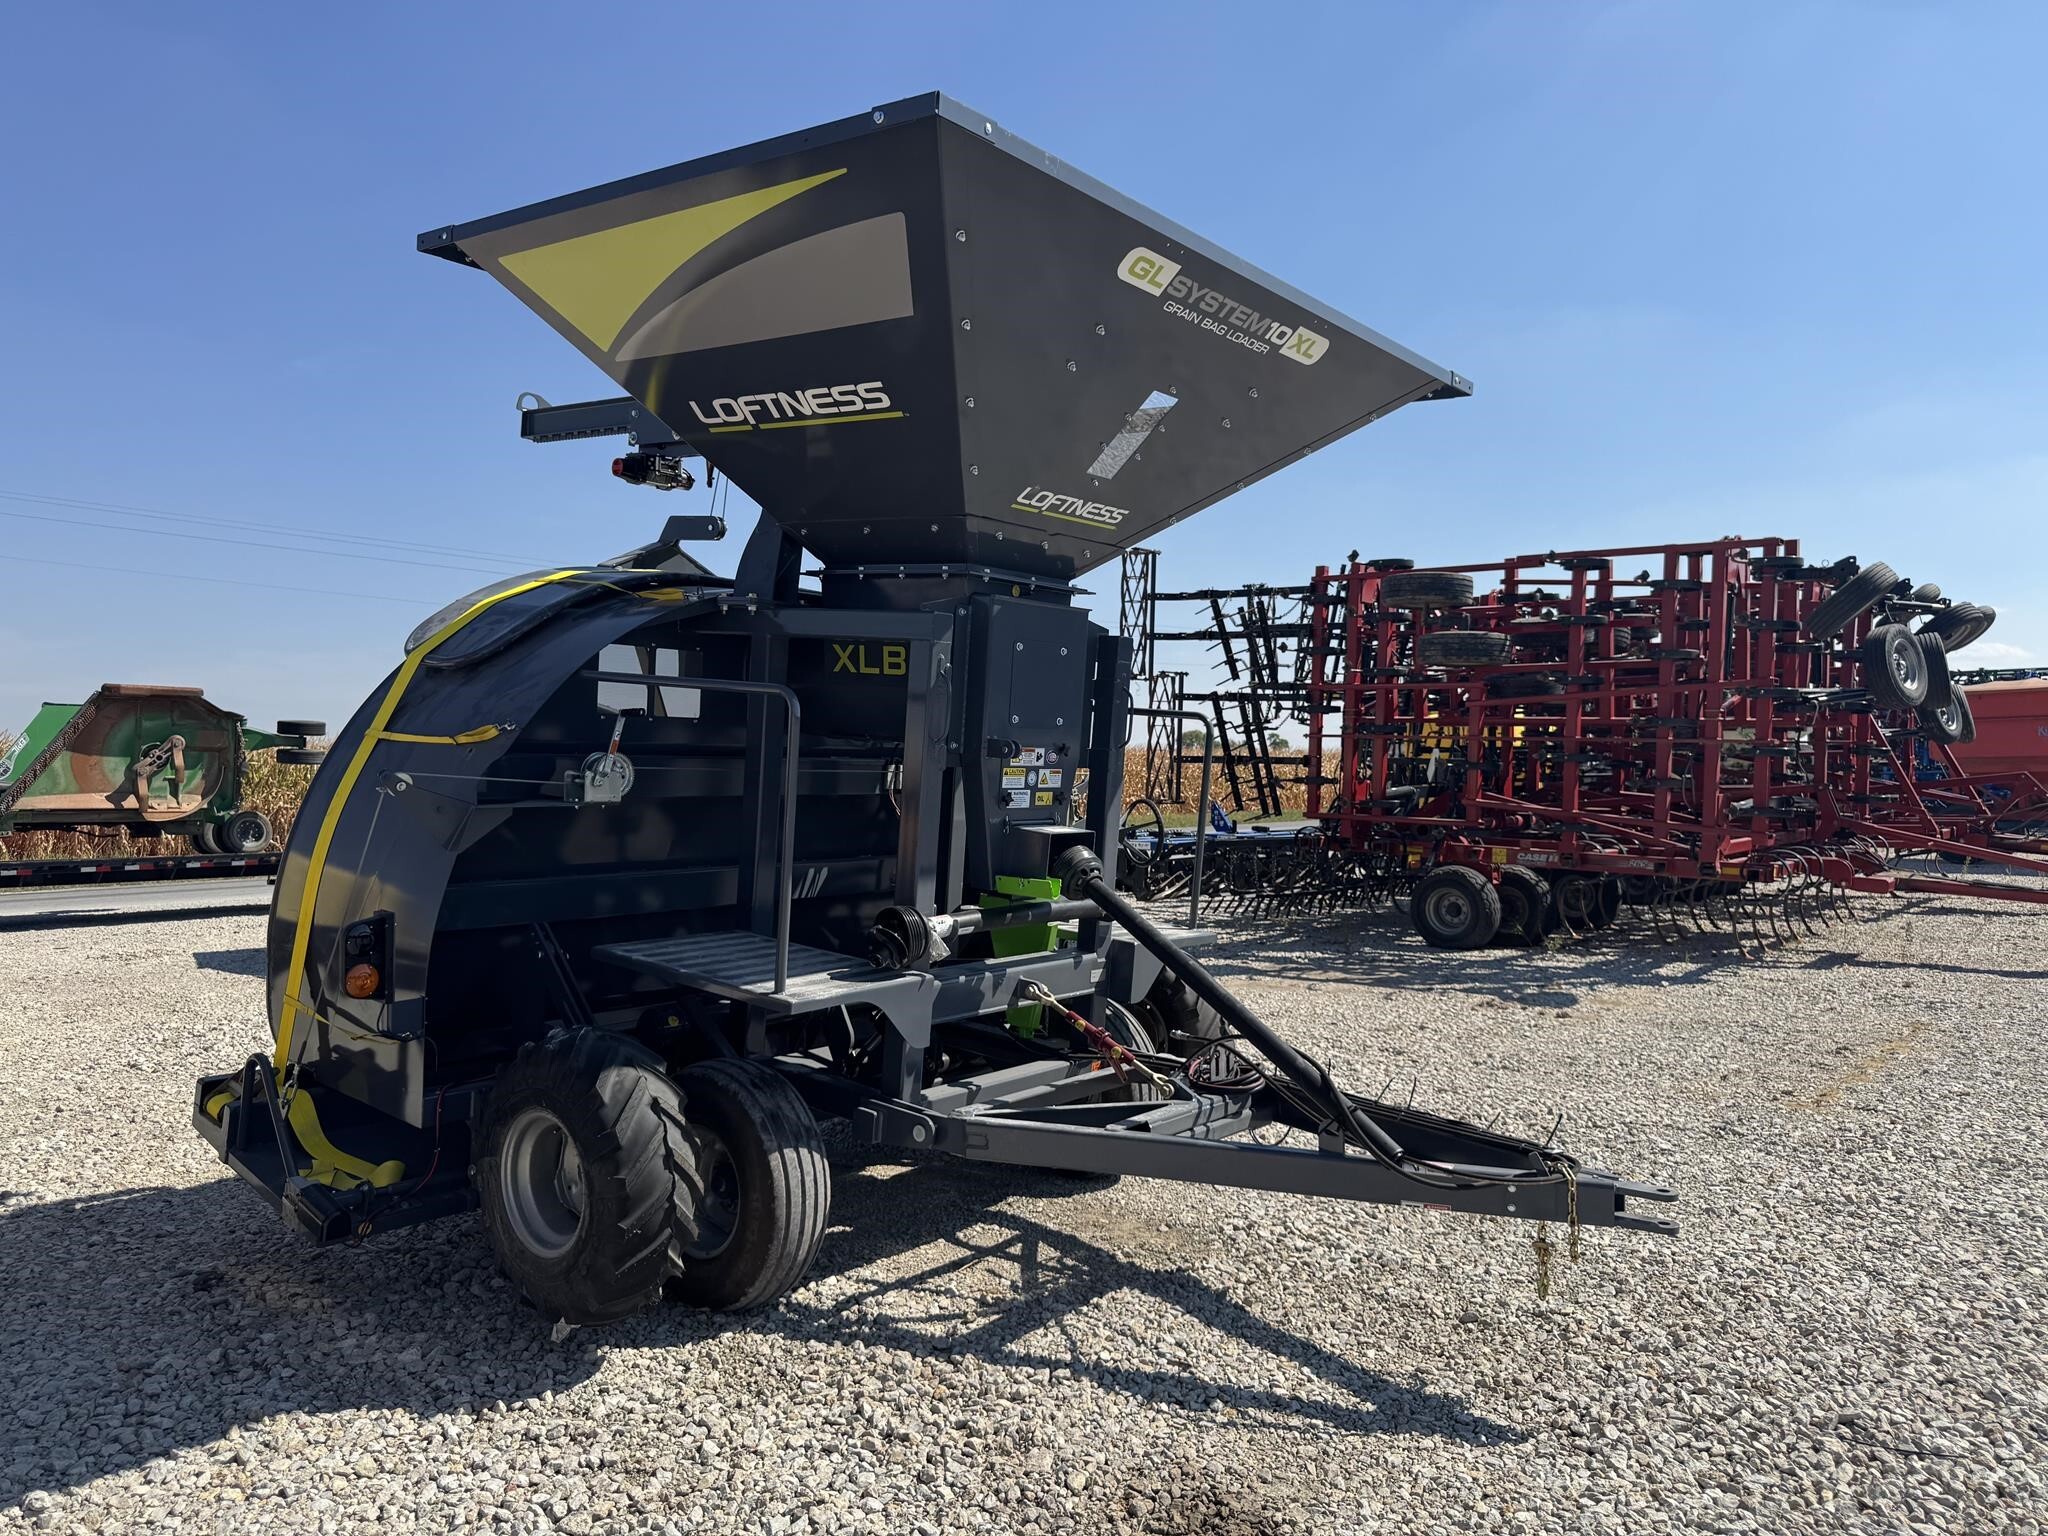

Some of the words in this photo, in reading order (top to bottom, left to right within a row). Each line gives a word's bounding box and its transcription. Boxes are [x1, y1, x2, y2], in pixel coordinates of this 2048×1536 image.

[1127, 255, 1165, 290] GL
[1287, 333, 1319, 360] XL
[1163, 300, 1202, 325] GRAIN
[1201, 317, 1228, 336] BAG
[1226, 329, 1270, 355] LOADER
[688, 381, 891, 425] LOFTNESS
[1016, 486, 1130, 524] LOFTNESS
[832, 643, 907, 676] XLB
[1517, 852, 1547, 862] CASE
